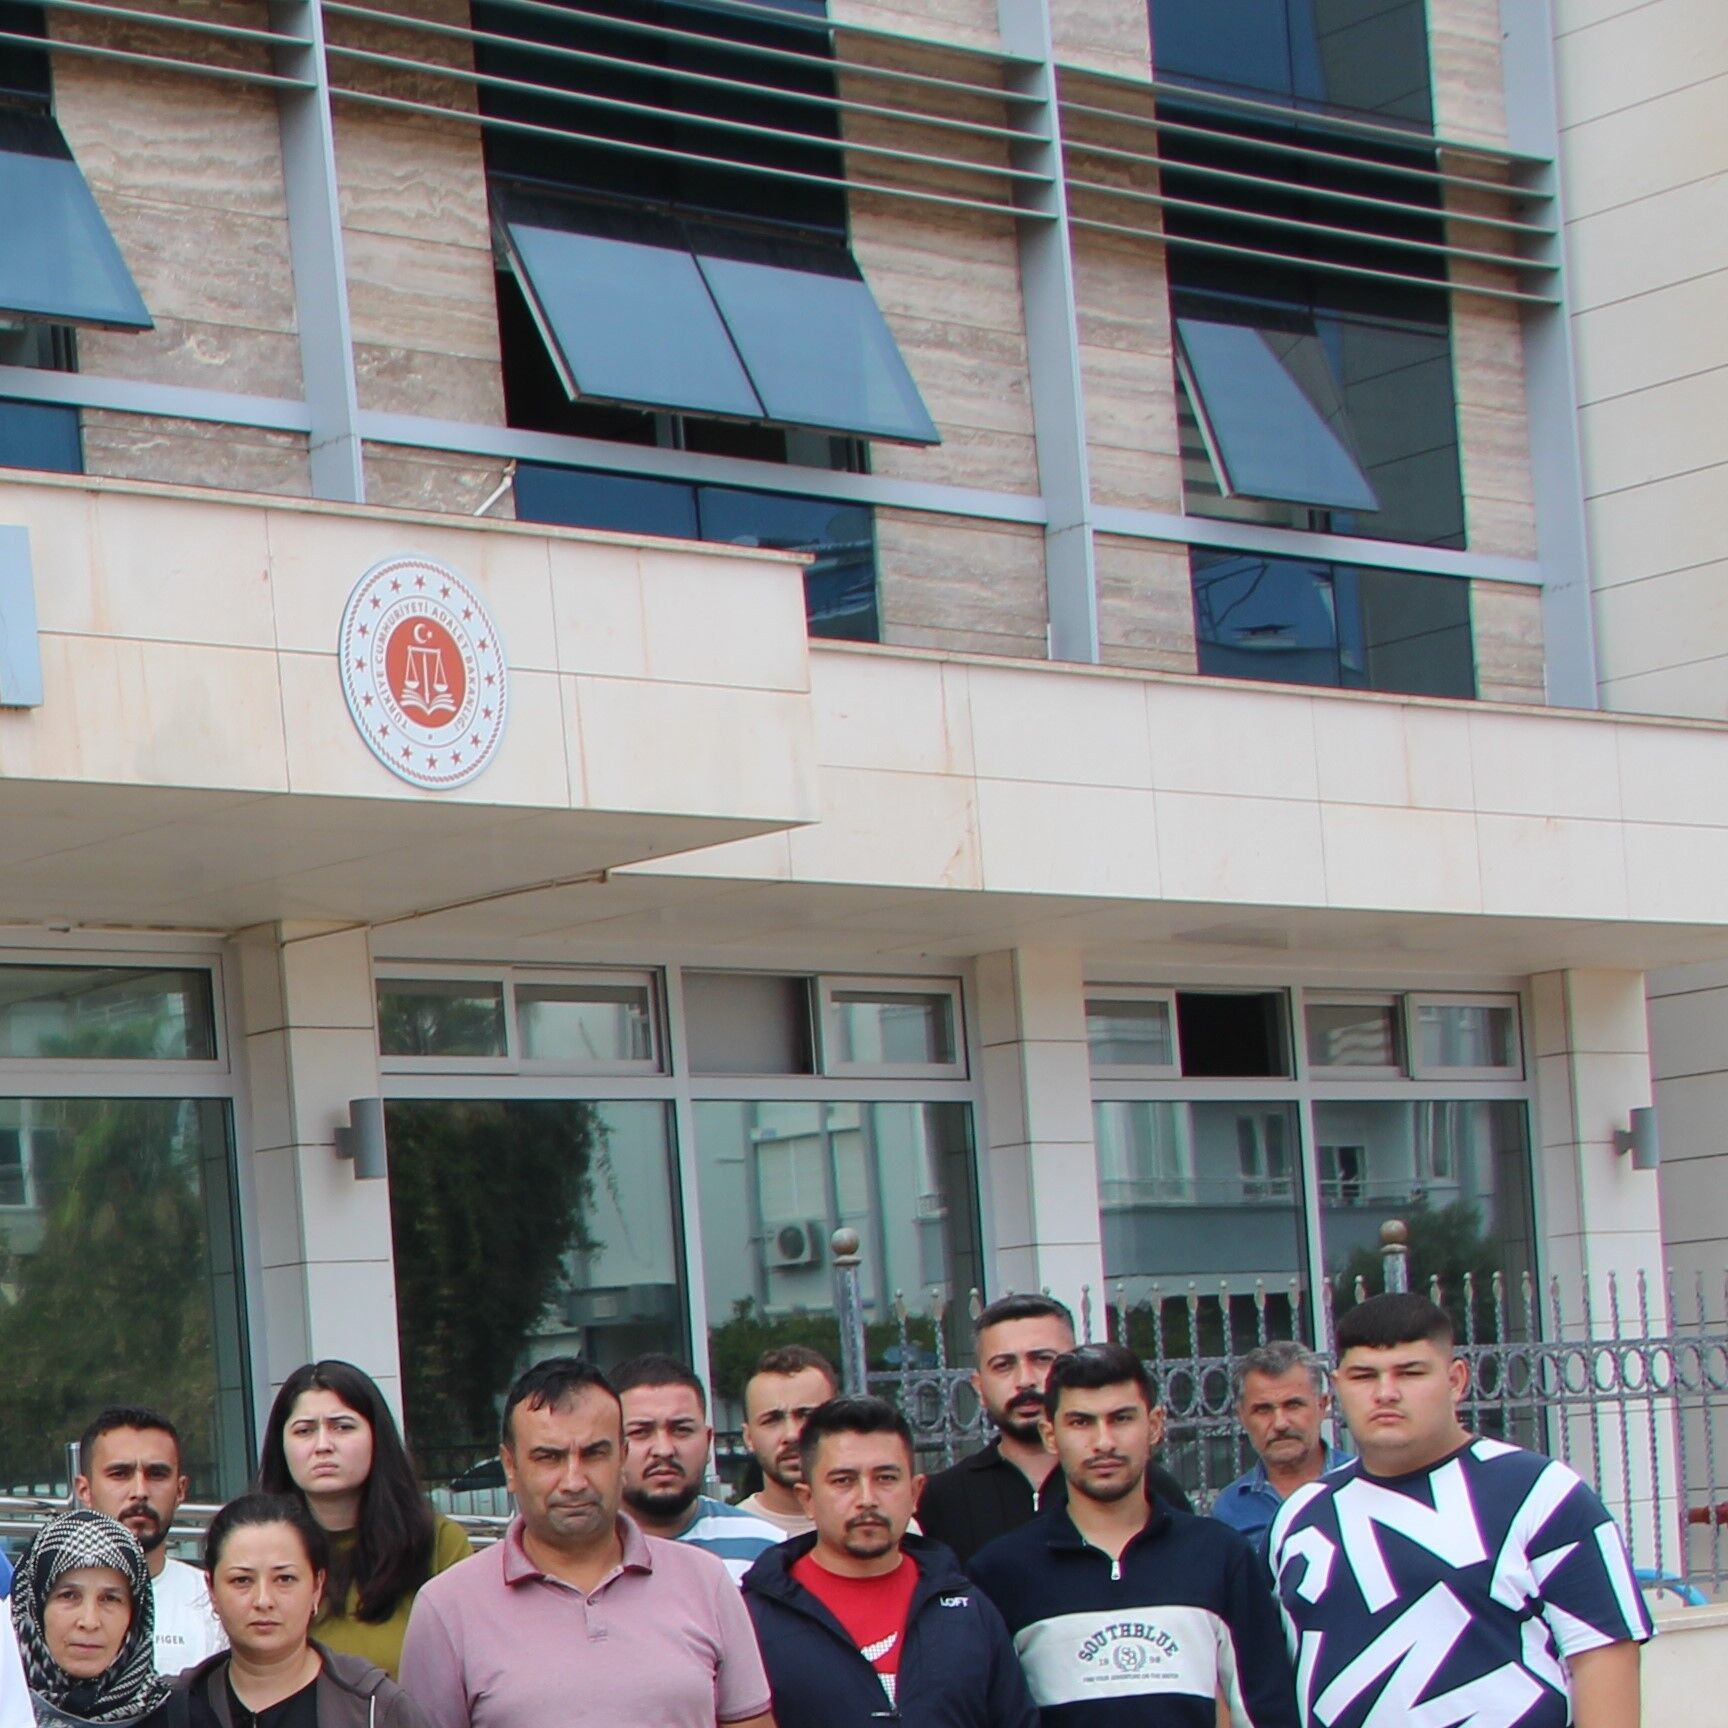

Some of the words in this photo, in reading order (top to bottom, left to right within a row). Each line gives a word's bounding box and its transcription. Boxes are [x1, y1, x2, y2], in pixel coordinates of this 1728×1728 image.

[939, 1596, 969, 1607] LOFT
[155, 1635, 185, 1645] FIGER
[1078, 1622, 1179, 1662] SOUTHBLUE
